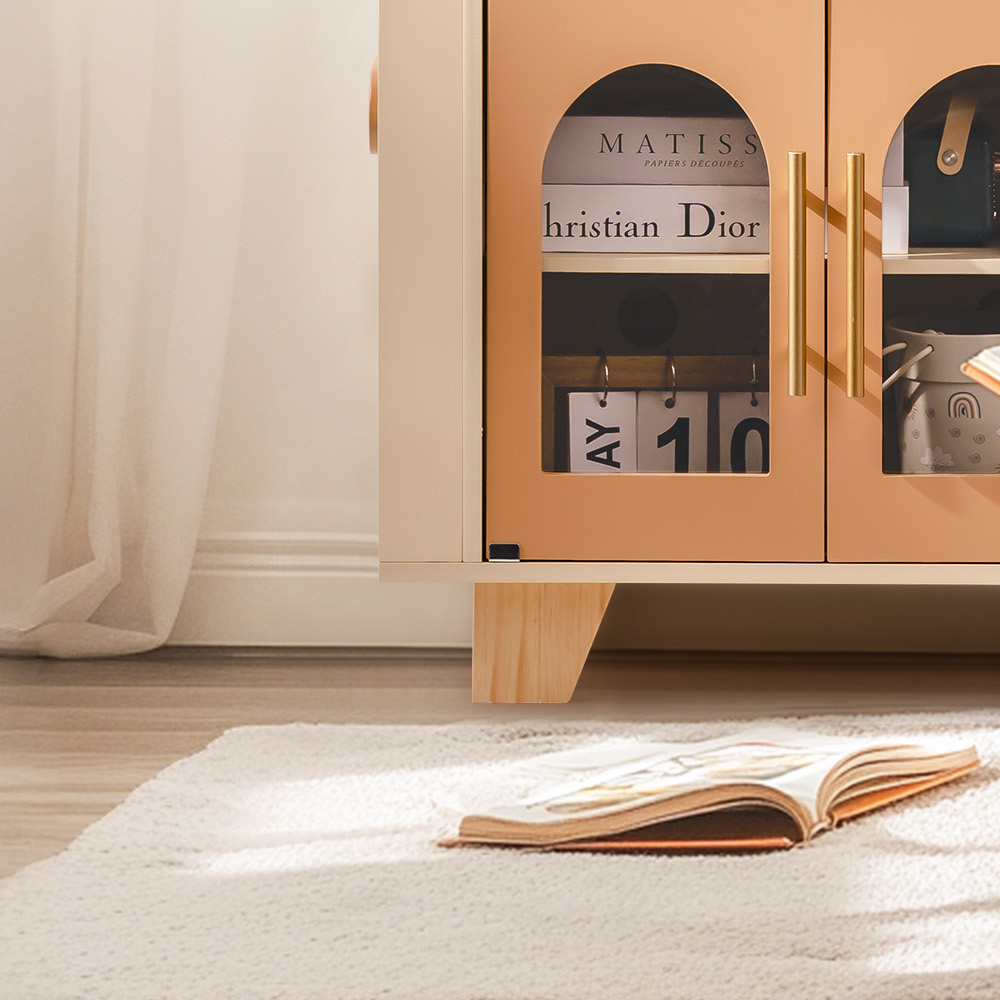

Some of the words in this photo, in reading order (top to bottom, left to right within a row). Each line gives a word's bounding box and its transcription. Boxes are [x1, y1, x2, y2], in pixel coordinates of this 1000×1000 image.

[598, 132, 758, 155] MATISS
[644, 160, 687, 168] PAPIERS
[543, 202, 660, 238] hristian
[677, 202, 761, 238] Dior
